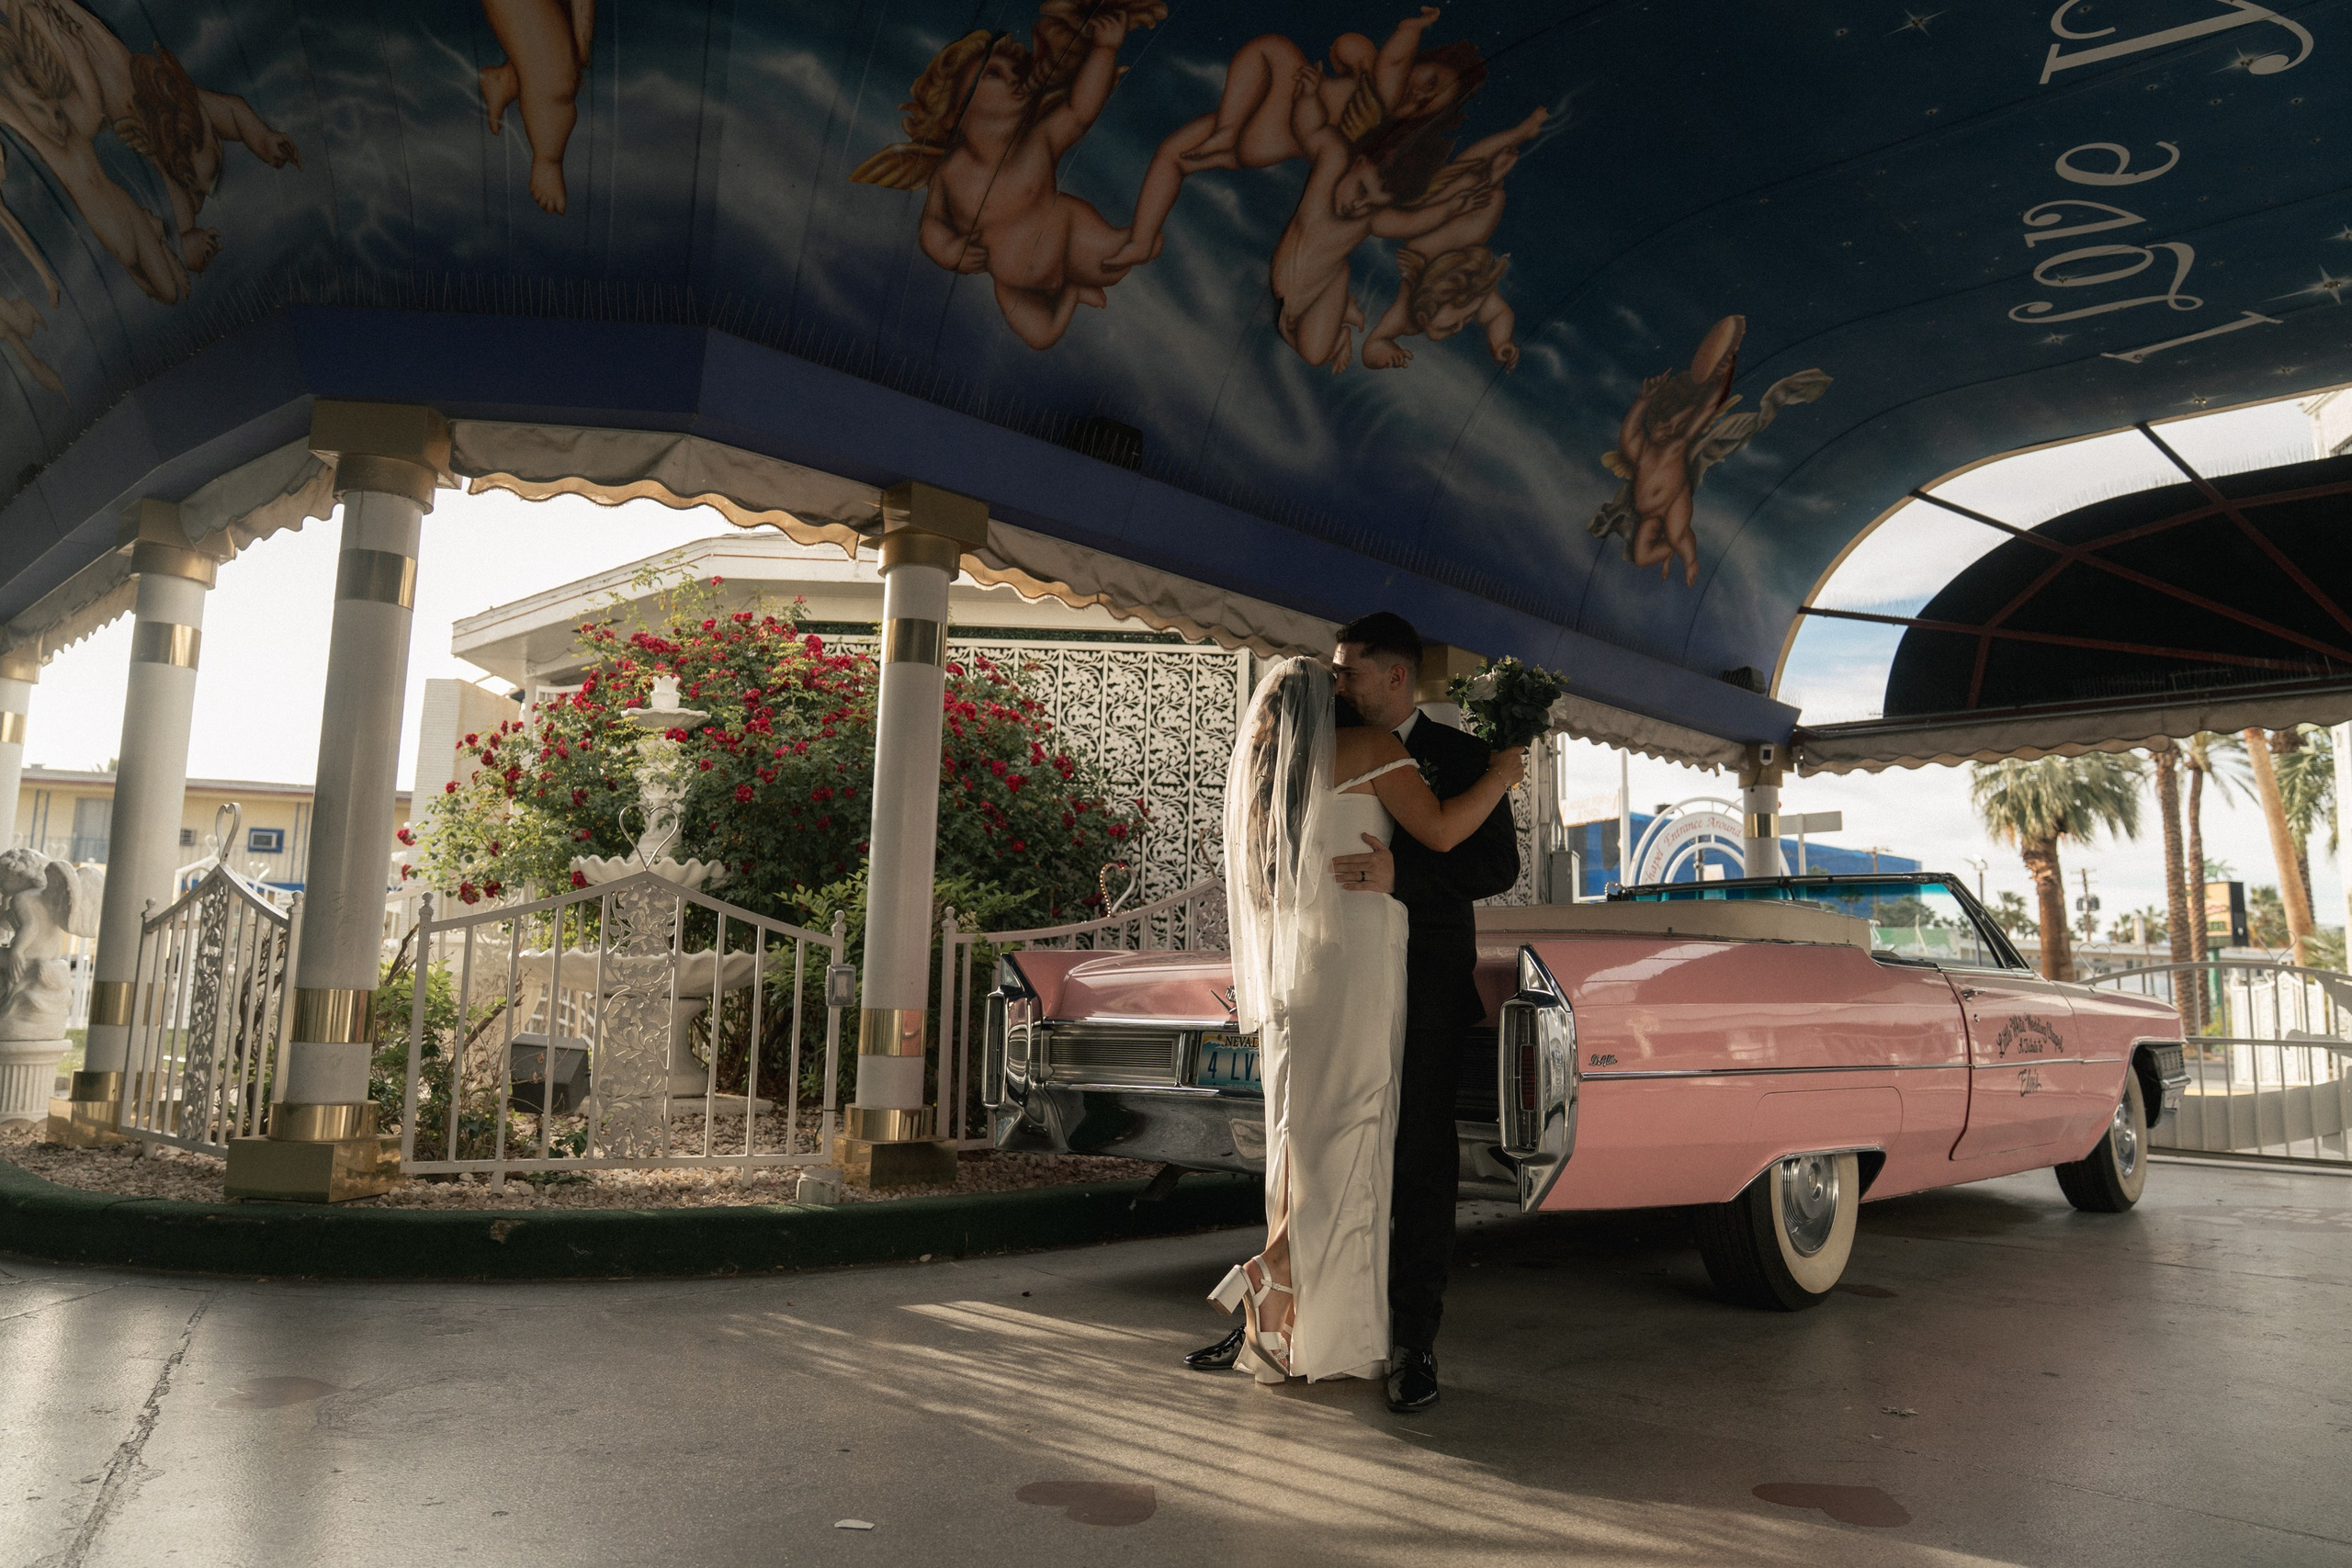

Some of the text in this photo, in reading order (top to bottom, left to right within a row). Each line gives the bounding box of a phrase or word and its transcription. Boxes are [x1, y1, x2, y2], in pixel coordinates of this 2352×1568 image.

[1645, 816, 1743, 883] hapel Entrance Around
[1225, 1035, 1259, 1047] NEVAD
[1207, 1051, 1218, 1079] 4
